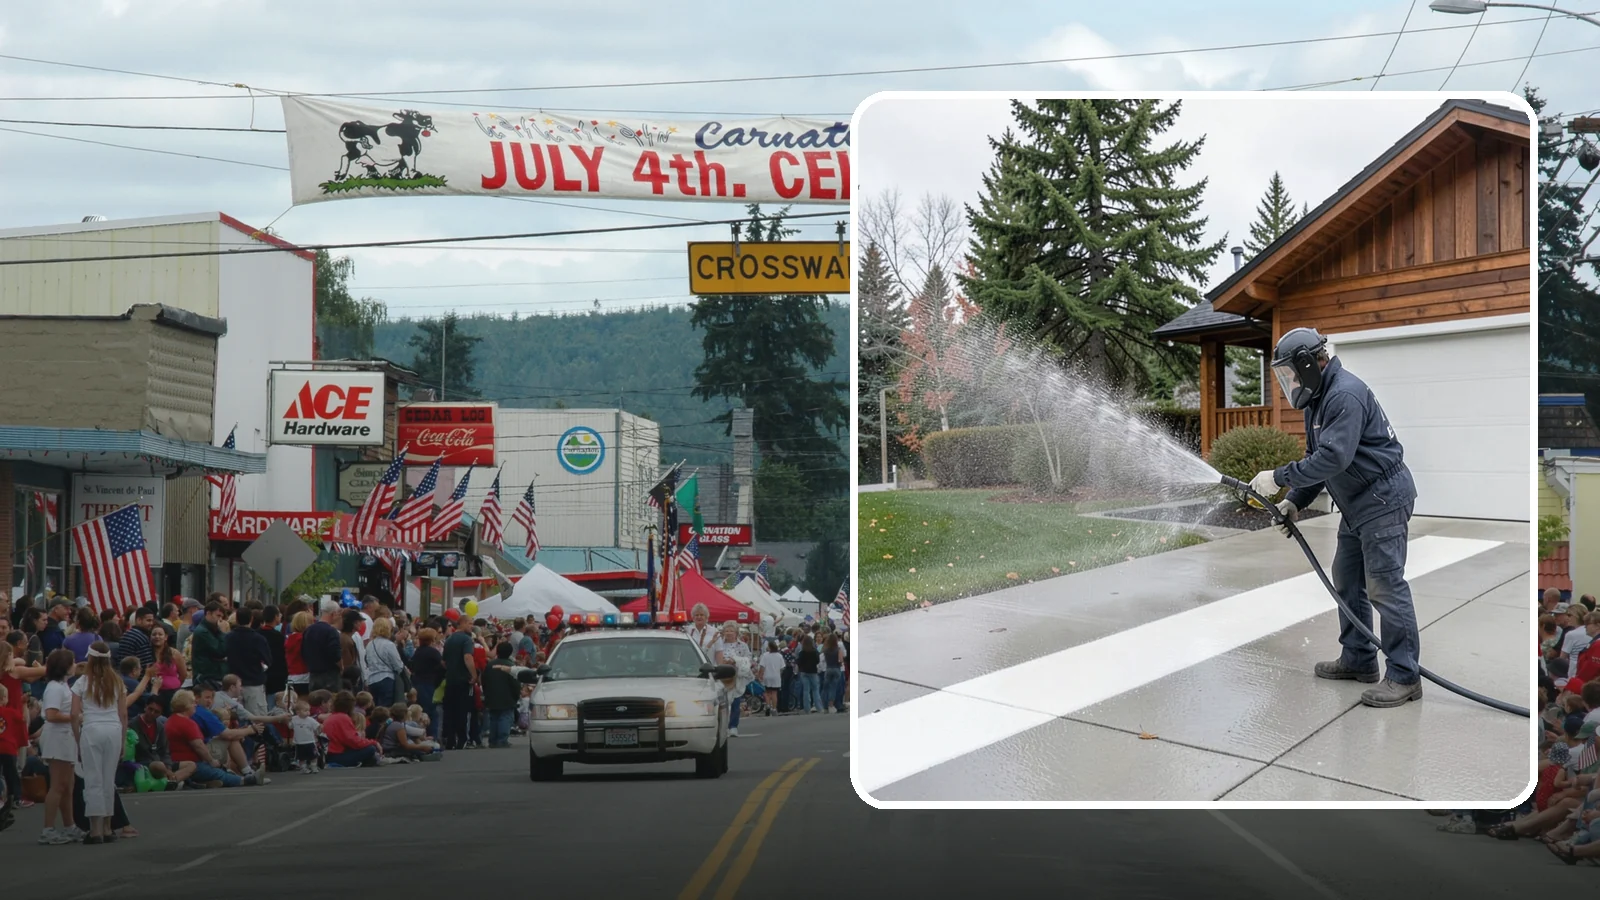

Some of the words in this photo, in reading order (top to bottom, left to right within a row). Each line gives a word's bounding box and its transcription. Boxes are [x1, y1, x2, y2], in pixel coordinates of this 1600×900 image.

[481, 141, 605, 193] JULY
[632, 150, 747, 198] 4th.
[696, 254, 850, 280] CROSSWA
[282, 380, 374, 420] ACE
[406, 409, 452, 422] CEDAR
[283, 421, 371, 437] Hardware
[416, 428, 477, 447] Coca-Cola
[353, 467, 385, 480] Simpl
[83, 486, 93, 494] St.
[95, 485, 124, 494] Vincent
[126, 486, 135, 494] de
[138, 486, 155, 495] Paul
[81, 503, 154, 522] THT
[212, 516, 330, 535] HARDARE
[688, 526, 741, 535] CRNATION
[699, 535, 730, 543] GLASS
